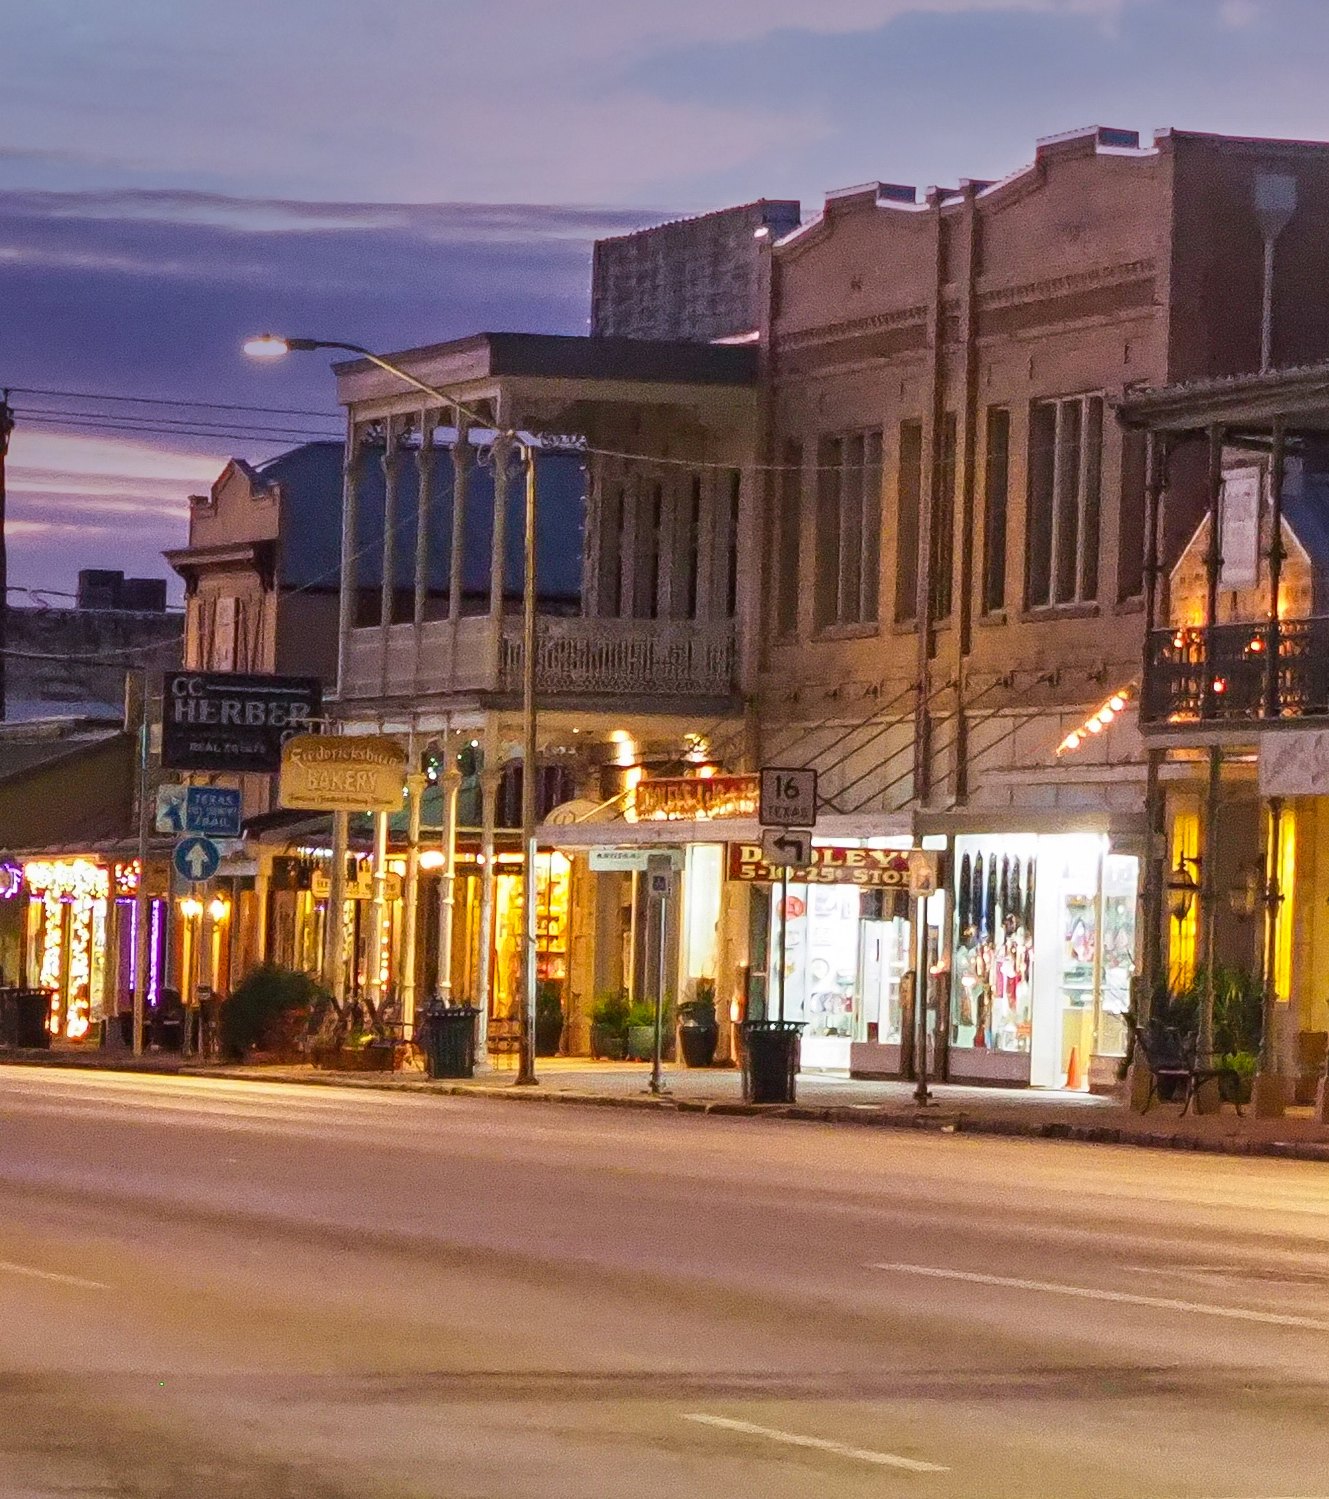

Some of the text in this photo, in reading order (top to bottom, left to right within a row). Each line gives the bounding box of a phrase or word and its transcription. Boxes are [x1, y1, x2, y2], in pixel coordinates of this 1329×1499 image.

[174, 698, 312, 727] HERBER
[307, 770, 377, 792] BAKERY
[775, 775, 800, 800] 16
[739, 845, 910, 868] DLEY'
